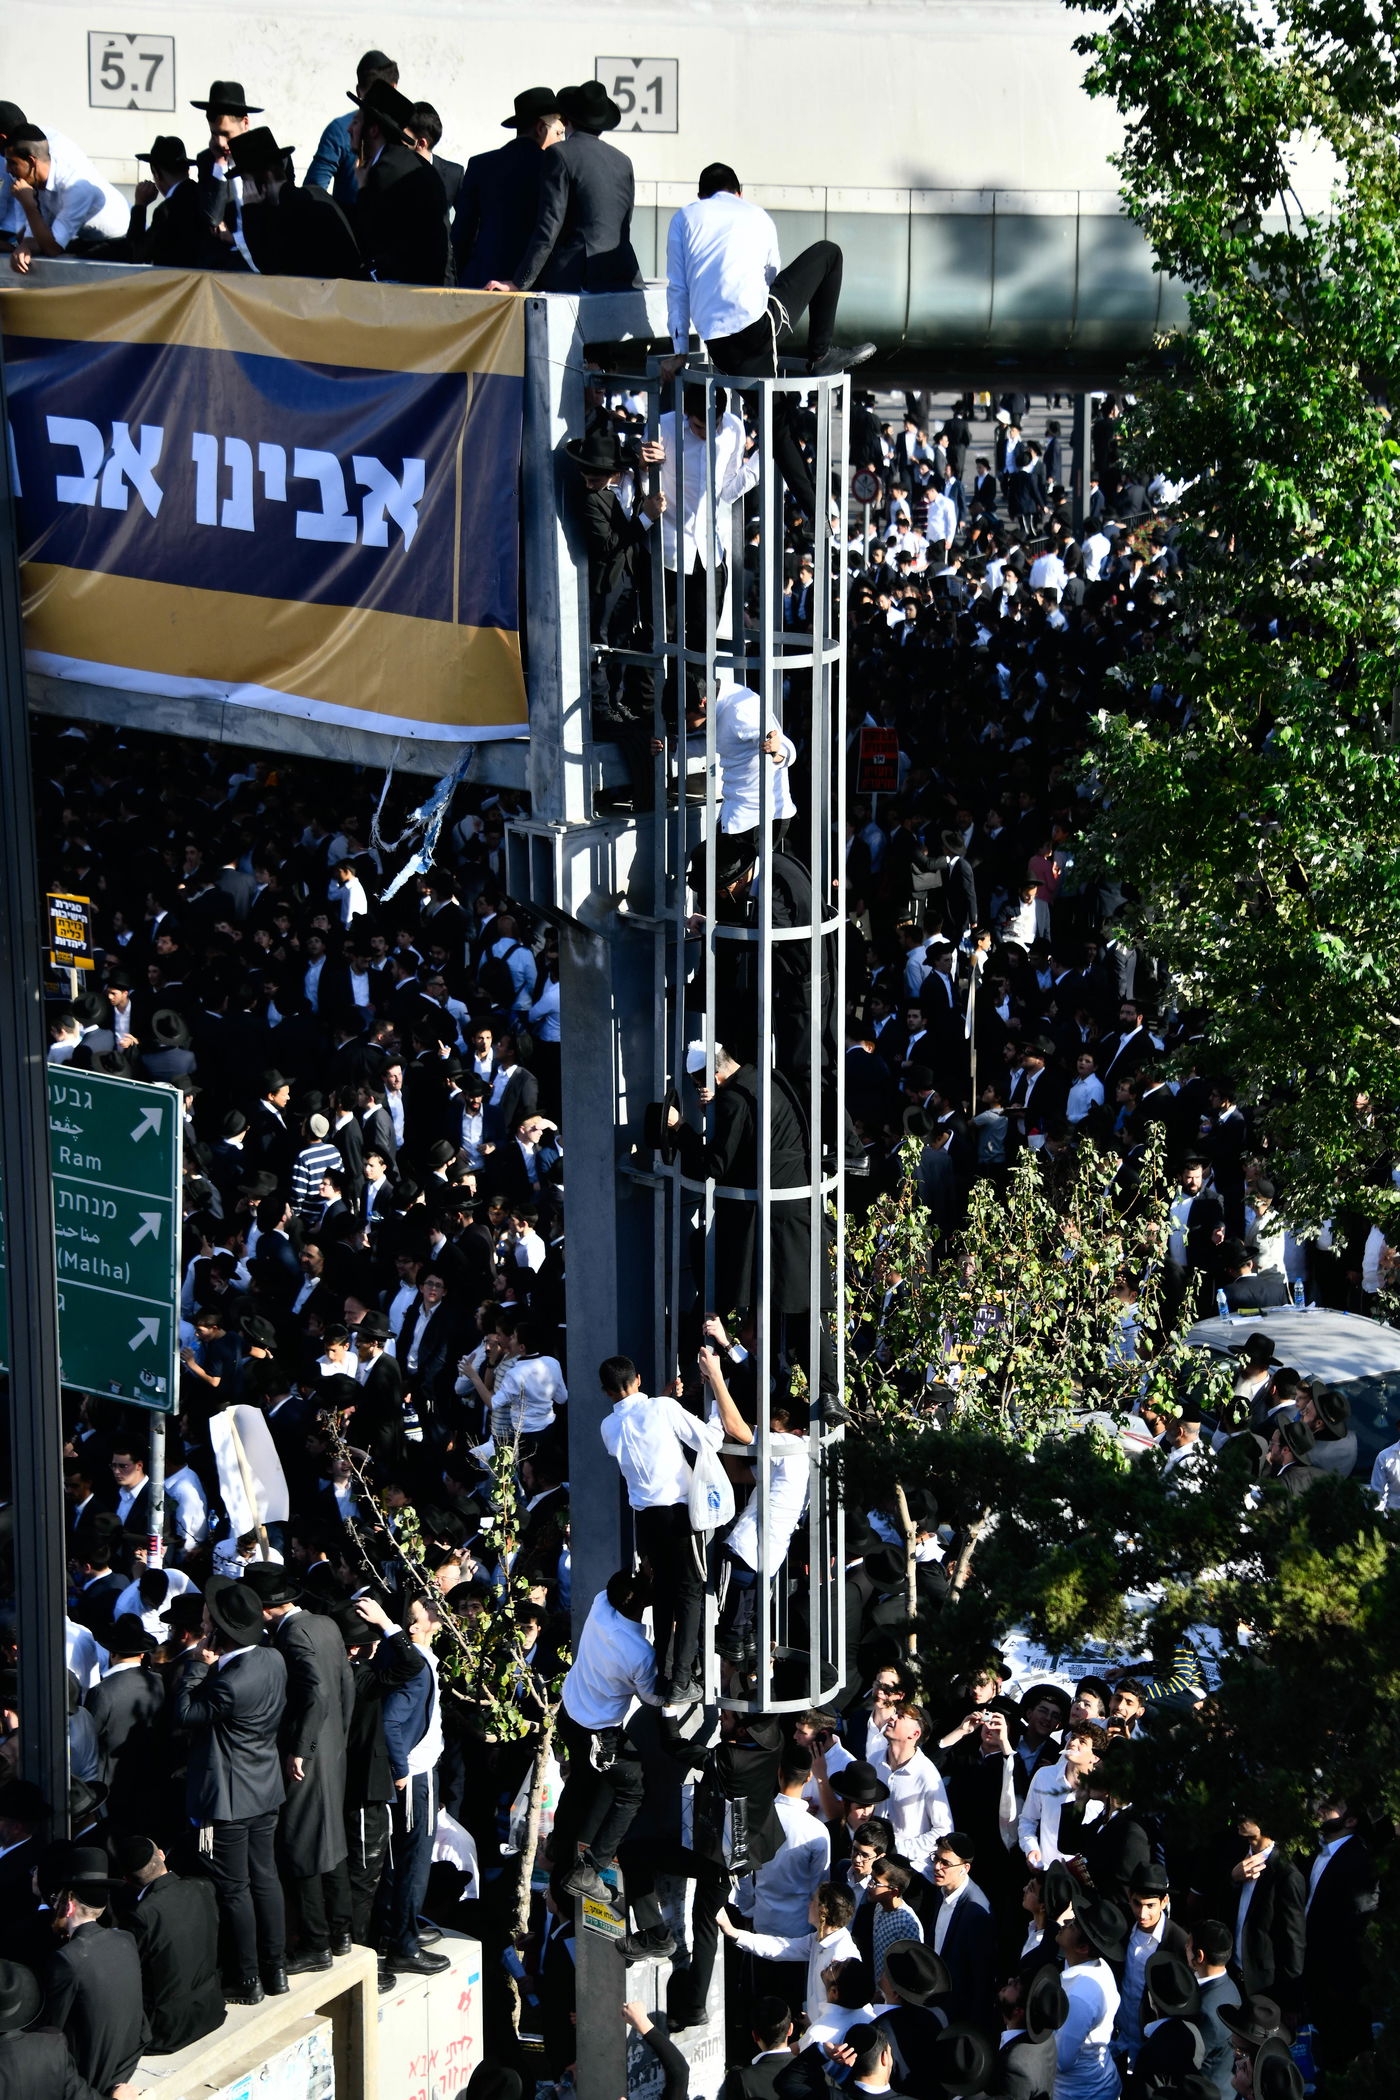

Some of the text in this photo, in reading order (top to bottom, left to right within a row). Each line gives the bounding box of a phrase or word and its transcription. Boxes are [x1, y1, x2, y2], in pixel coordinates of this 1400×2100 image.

[100, 51, 164, 92] 5.7
[613, 75, 662, 115] 5.1
[46, 415, 164, 520] אב
[192, 431, 426, 553] אבינו
[50, 907, 88, 923] הישיבות
[55, 899, 82, 913] סגירת
[57, 918, 82, 930] גזירת
[60, 928, 81, 938] כליה
[54, 936, 87, 950] ליהדות
[60, 1146, 102, 1171] Ram
[58, 1190, 117, 1219] מנחת
[58, 1247, 130, 1284] (Malha)
